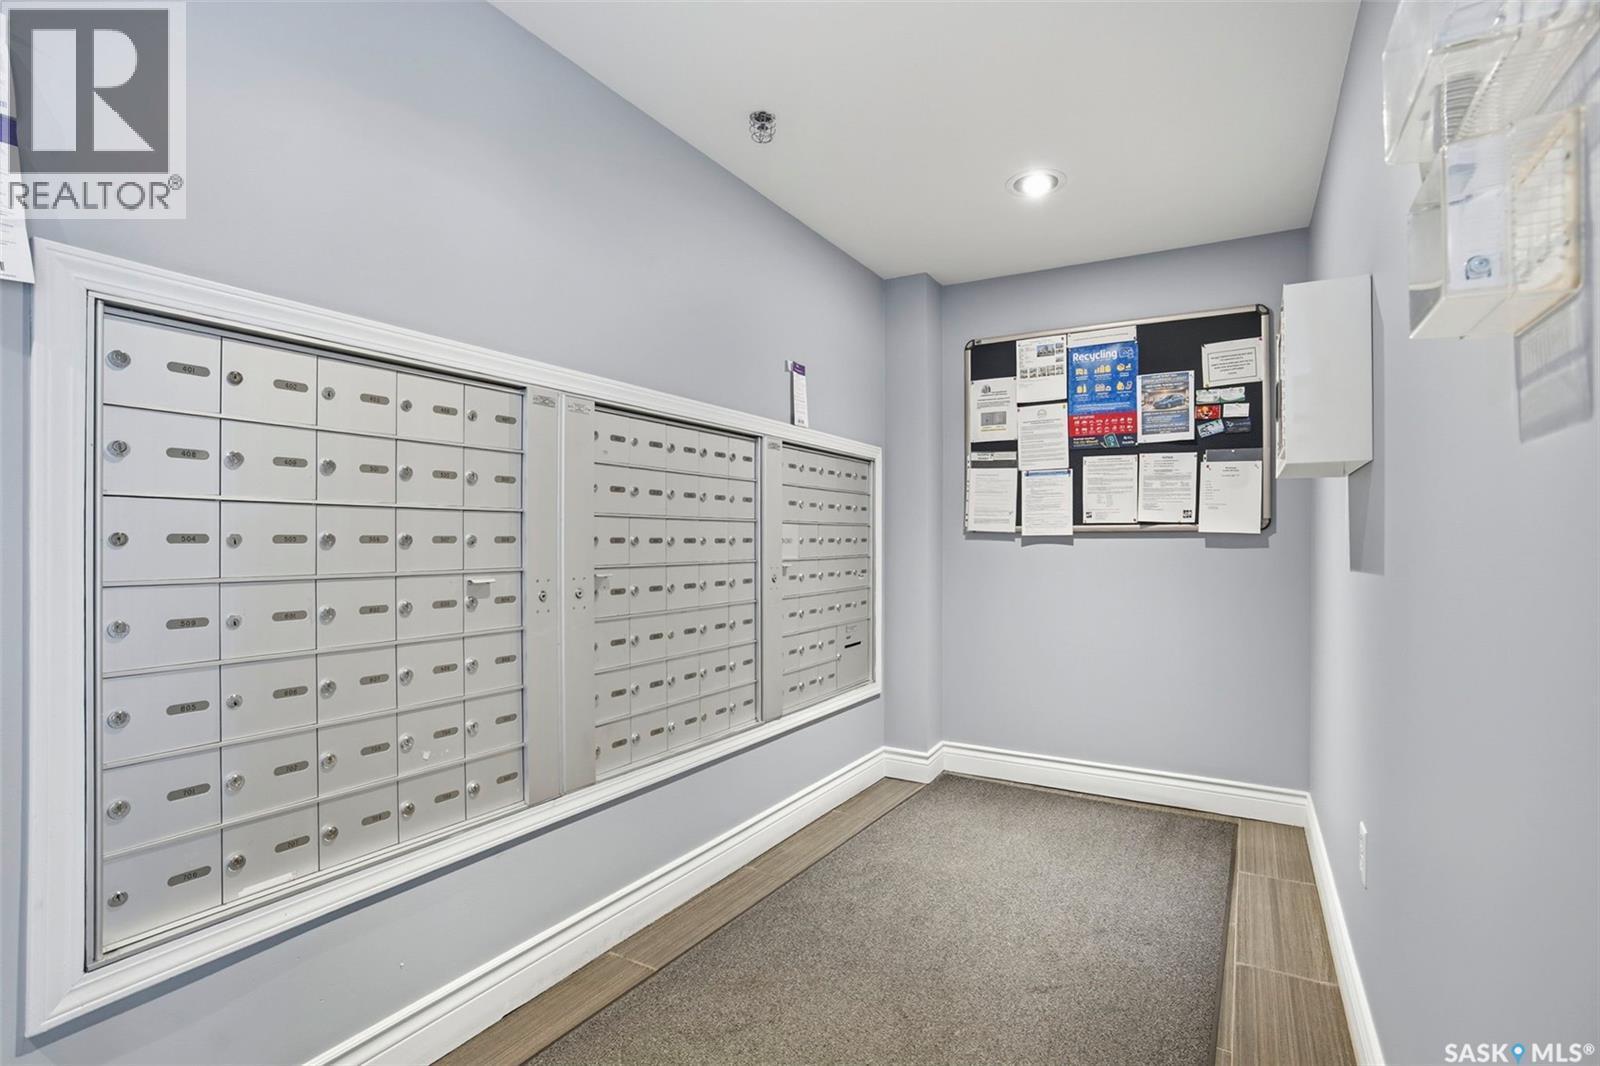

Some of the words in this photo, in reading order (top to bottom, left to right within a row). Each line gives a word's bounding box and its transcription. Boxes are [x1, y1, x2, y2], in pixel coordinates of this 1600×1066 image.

[1072, 349, 1118, 362] Recycling
[182, 365, 196, 375] 401
[181, 535, 196, 543] 504
[180, 619, 197, 628] 509
[180, 704, 197, 713] 605
[183, 787, 196, 797] 701
